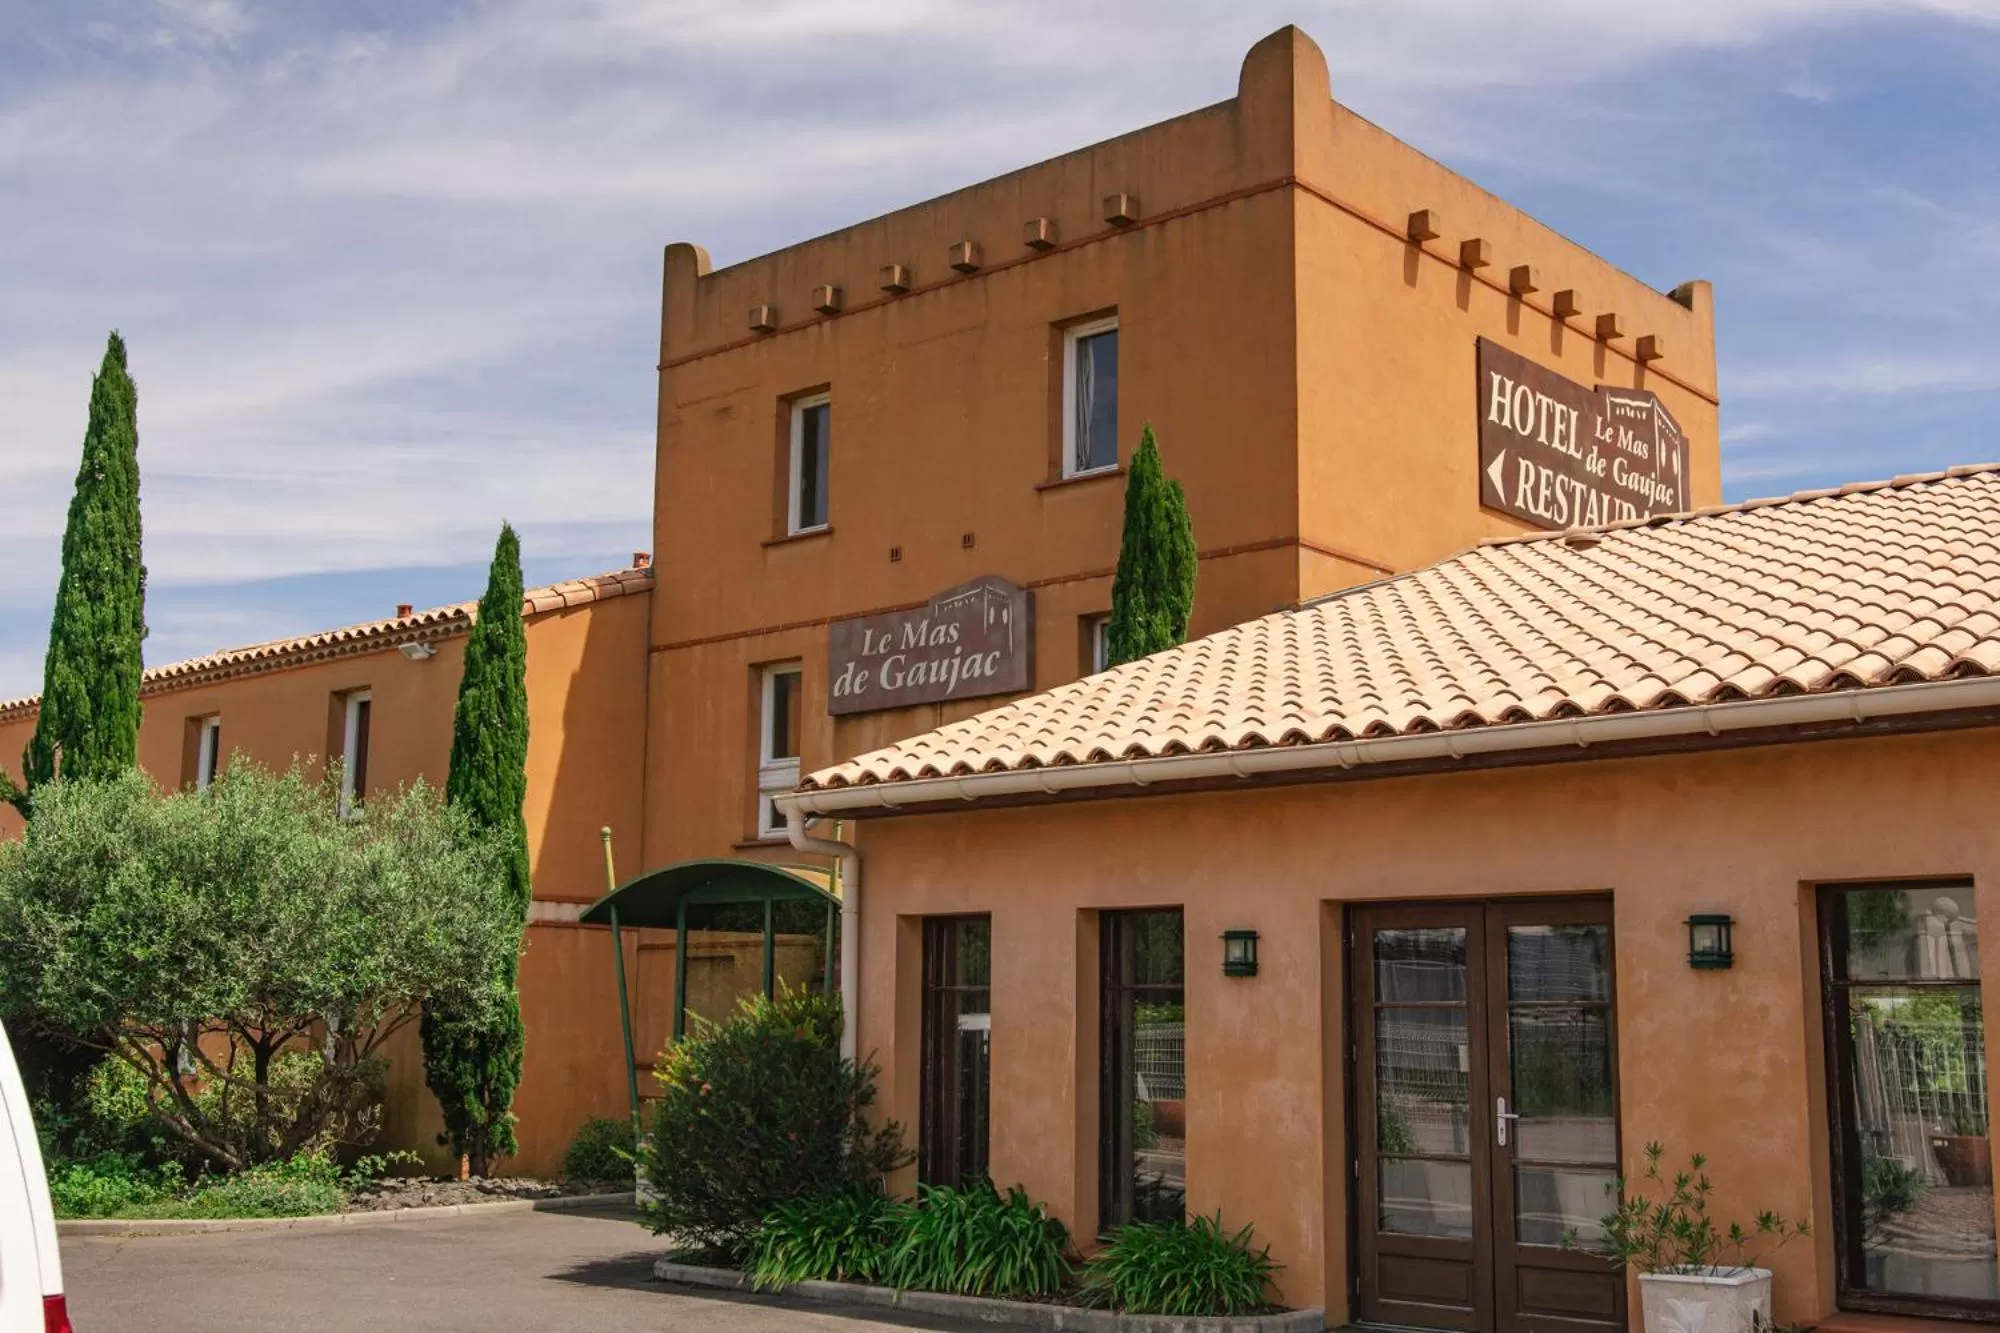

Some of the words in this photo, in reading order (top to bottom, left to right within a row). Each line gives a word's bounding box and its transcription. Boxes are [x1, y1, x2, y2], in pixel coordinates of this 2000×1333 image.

[1488, 371, 1583, 460] HOTEL
[1596, 415, 1613, 442] Le
[1617, 425, 1649, 459] Mas
[1515, 457, 1651, 528] RESTAU
[1585, 446, 1607, 477] de
[1613, 456, 1674, 507] Gaujac
[862, 629, 892, 656] Le
[900, 619, 960, 650] Mas
[833, 661, 869, 697] de
[879, 646, 1001, 695] Gaujac
